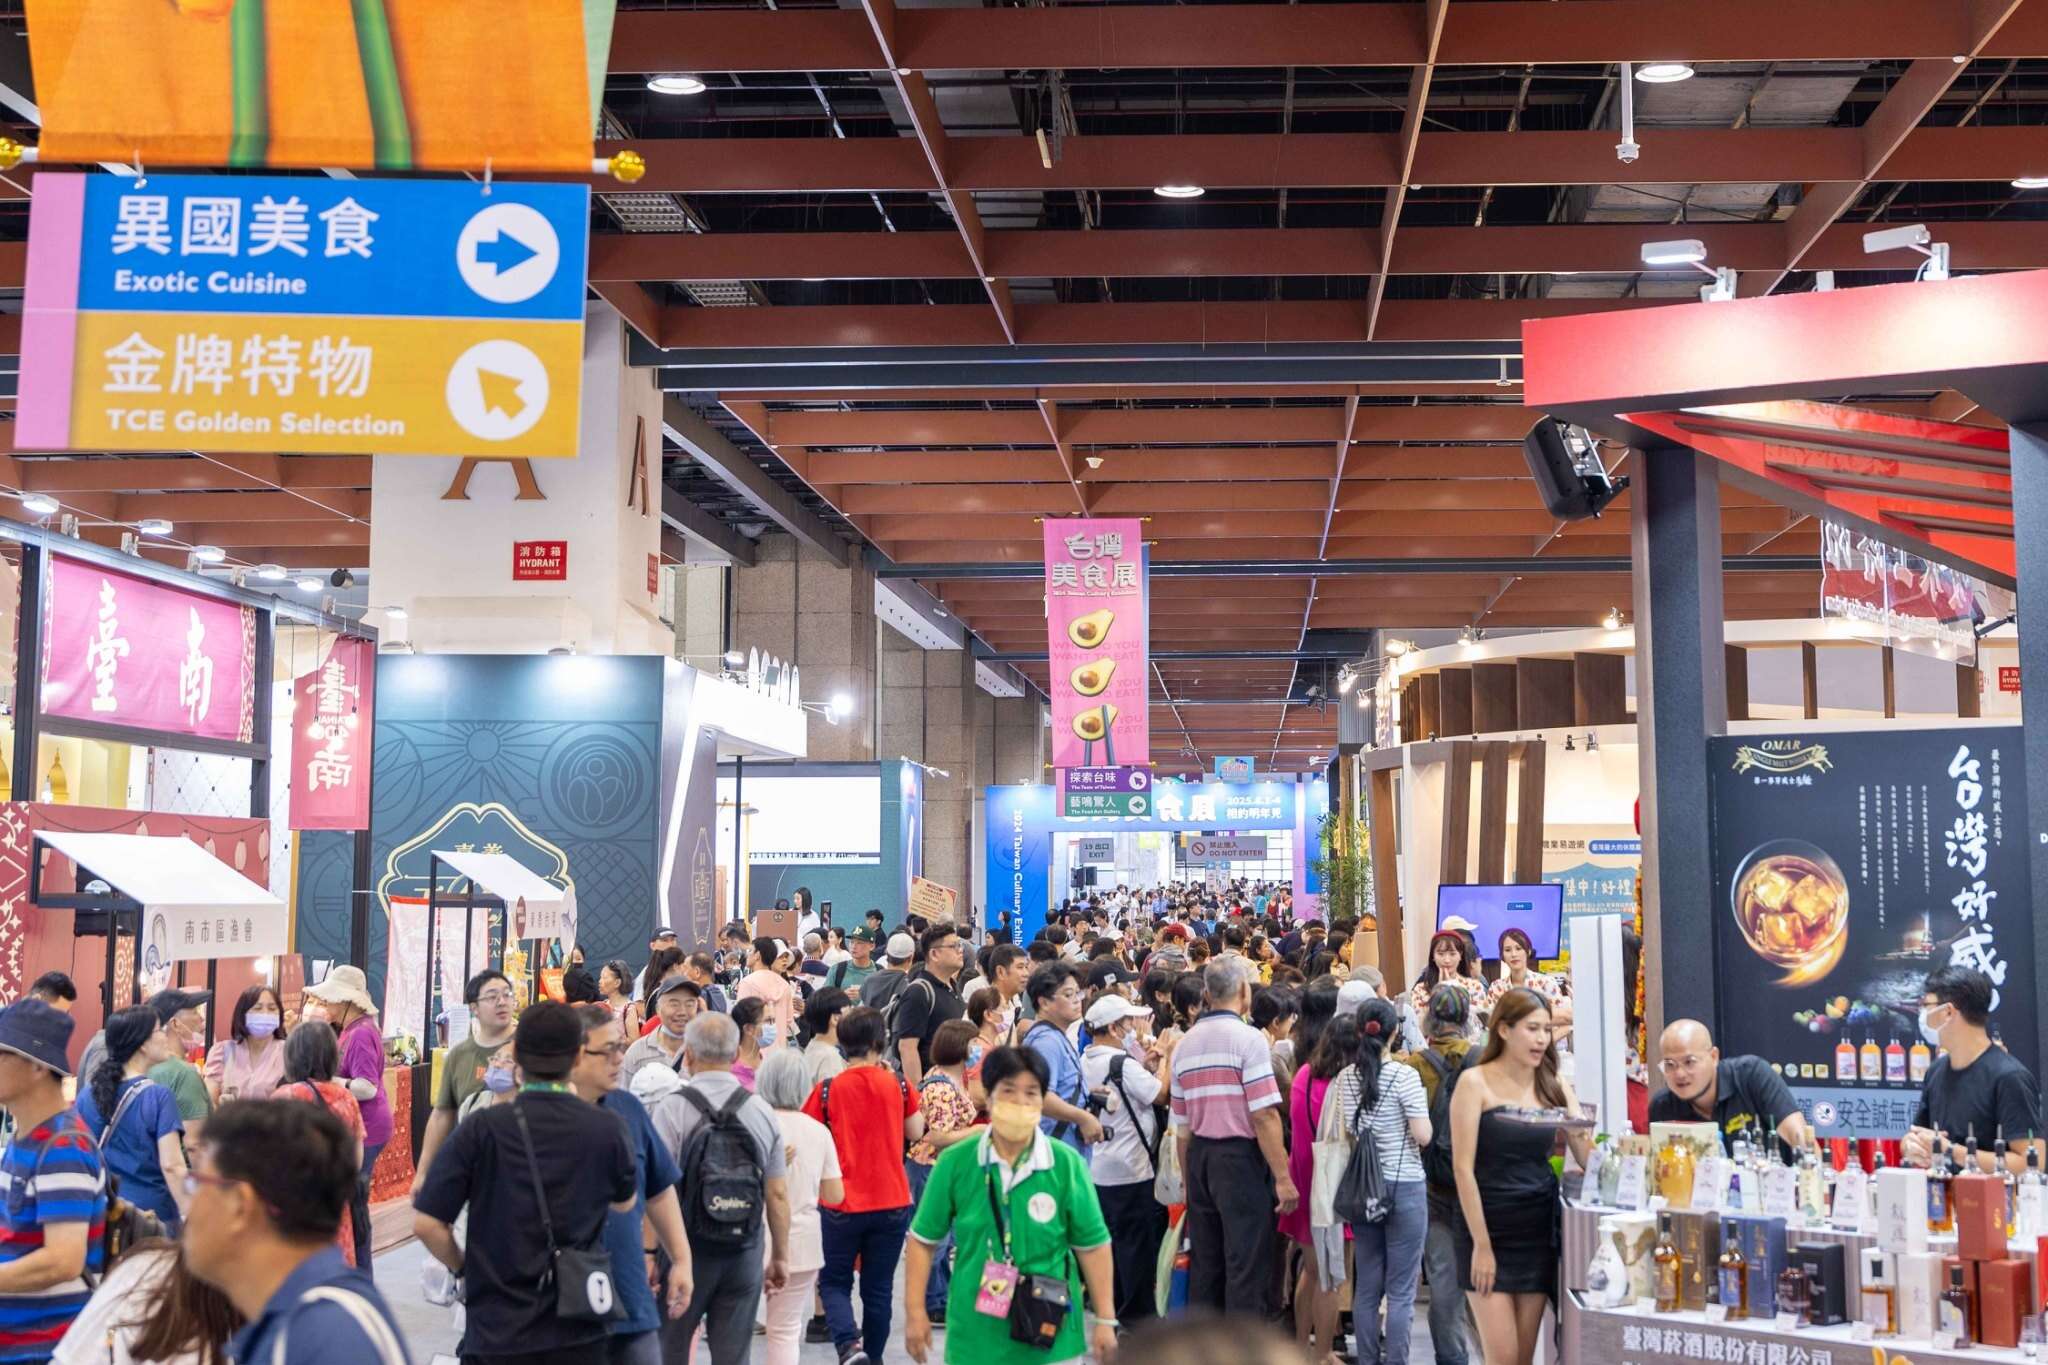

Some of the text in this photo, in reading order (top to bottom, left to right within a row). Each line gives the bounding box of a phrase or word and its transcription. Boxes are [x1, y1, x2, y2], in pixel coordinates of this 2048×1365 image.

[111, 195, 380, 261] 異國美食
[115, 269, 307, 296] Exotic Cuisine
[103, 330, 375, 399] 金牌特物
[107, 410, 406, 437] TCE Golden Selection
[519, 545, 561, 557] 消防箱
[1064, 532, 1122, 560] 台灣
[519, 558, 561, 568] HYDRANT
[1052, 562, 1137, 589] 美食展
[1761, 739, 1801, 751] OMAR
[1070, 771, 1116, 784] 探索台味
[1088, 851, 1105, 859] EXIT
[1012, 809, 1023, 947] 2024 Taiwan Culinary Exhib
[1622, 1324, 1834, 1365] 臺灣菸酒股份有限公司
